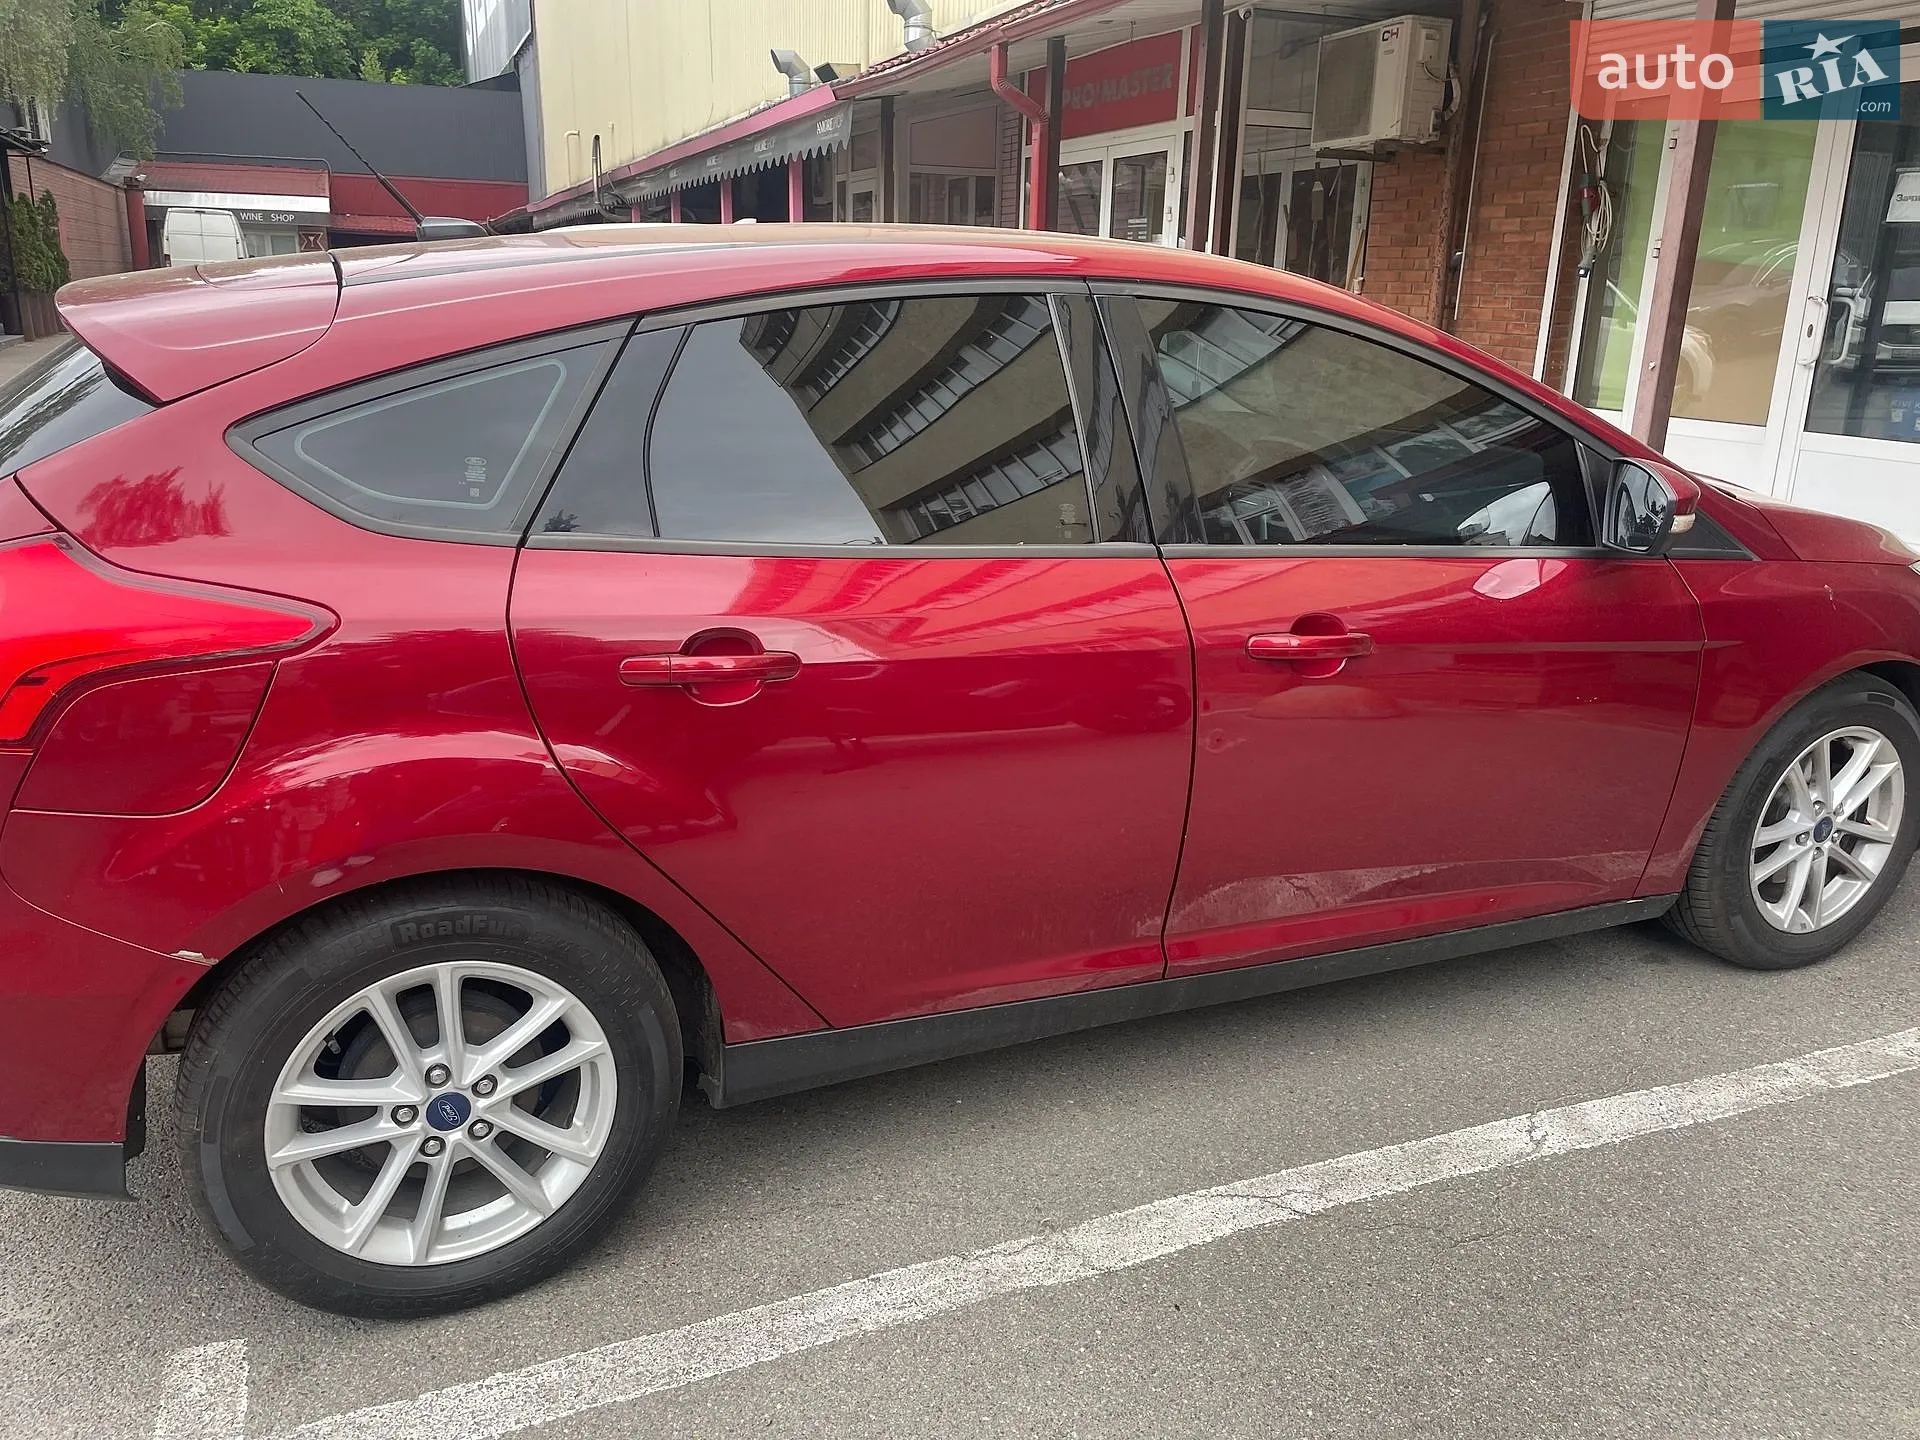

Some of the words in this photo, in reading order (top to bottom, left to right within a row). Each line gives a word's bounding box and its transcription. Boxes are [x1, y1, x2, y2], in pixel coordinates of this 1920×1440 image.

[1381, 27, 1399, 42] CH
[240, 212, 264, 221] WINE
[270, 213, 295, 222] SHOP
[440, 1103, 459, 1122] Ford
